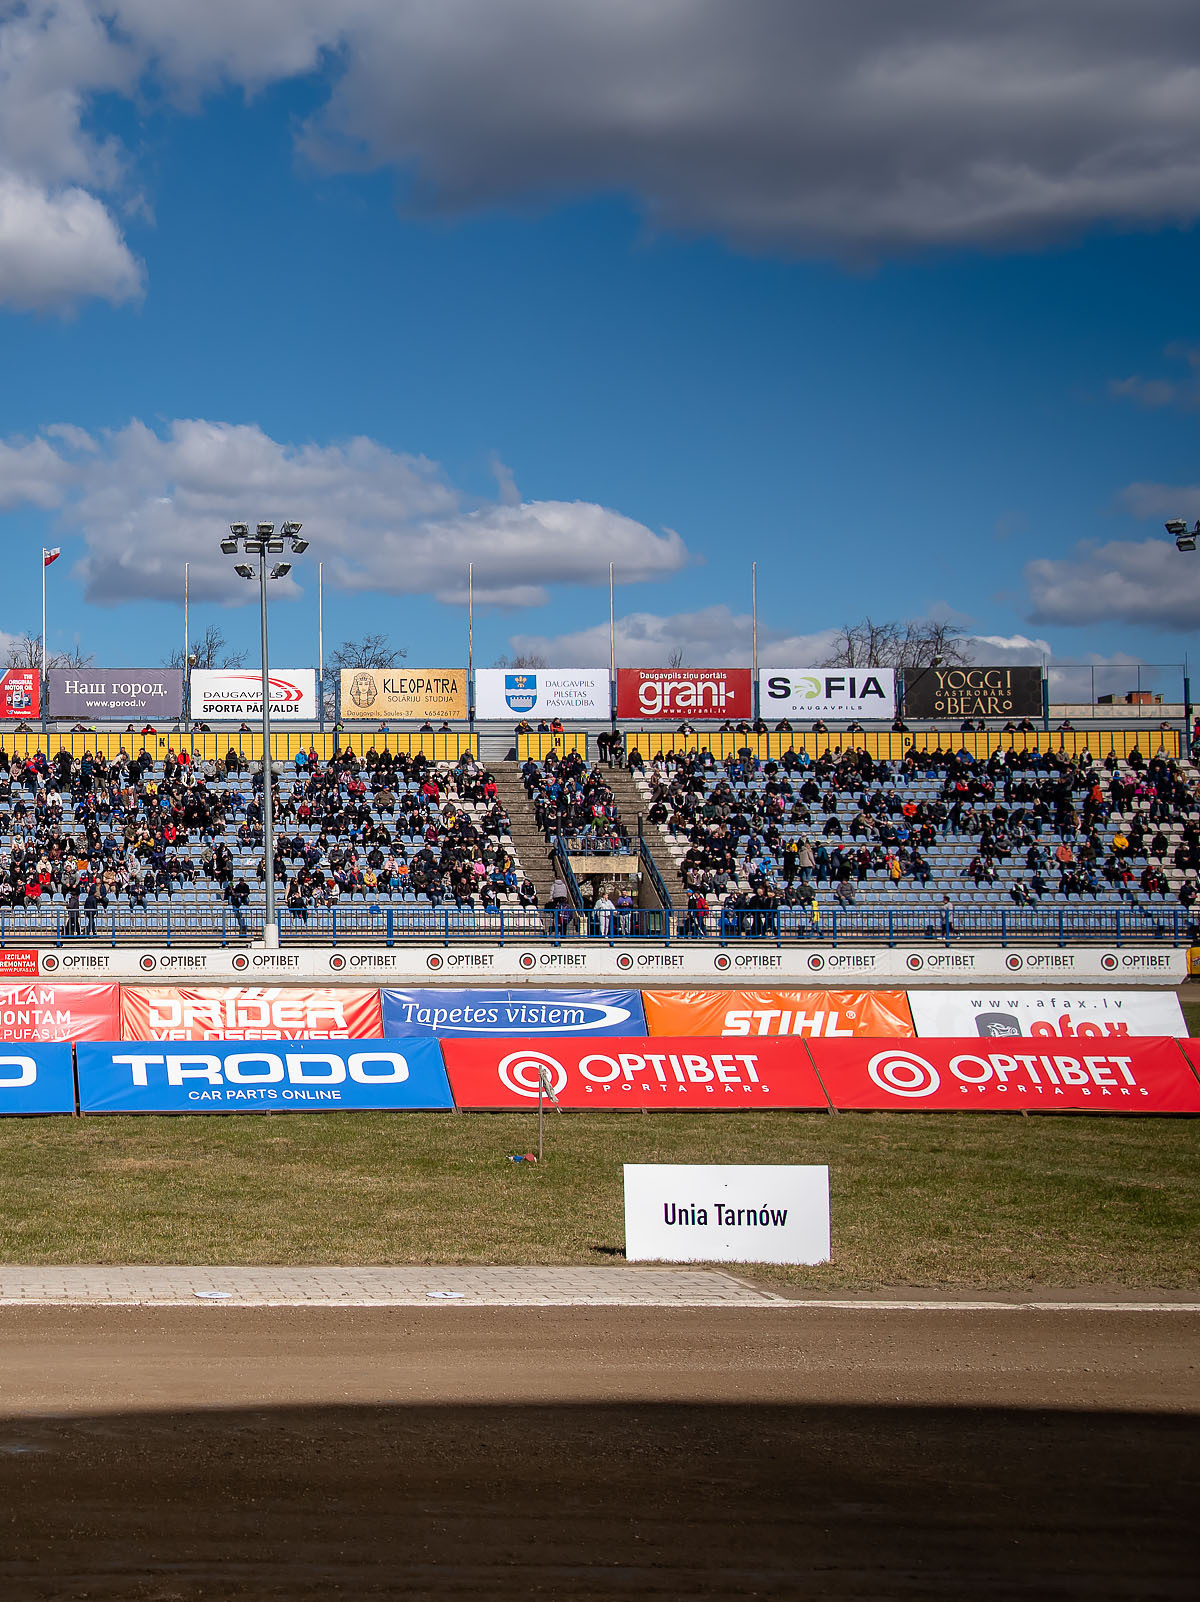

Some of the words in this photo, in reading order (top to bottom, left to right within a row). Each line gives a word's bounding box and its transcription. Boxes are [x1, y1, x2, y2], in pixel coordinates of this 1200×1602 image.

[640, 672, 681, 681] Daugavpils
[935, 671, 1011, 689] YOGGI
[64, 681, 105, 694] Наш
[112, 681, 168, 697] город.
[383, 678, 458, 694] KLEOPATRA
[545, 680, 595, 688] DAUGAVPILS
[203, 691, 284, 699] DAUGAVPLS
[638, 682, 727, 715] grani
[86, 699, 146, 708] www.gorod.lv
[202, 704, 243, 713] SPORTA
[947, 698, 1005, 715] BEAR
[159, 737, 166, 747] K
[554, 737, 561, 747] H
[904, 737, 911, 747] G
[63, 956, 110, 967] OPTIBET
[160, 956, 207, 967] OPTIBET
[252, 955, 300, 966] OPTIBET
[350, 955, 397, 966] OPTIBET
[447, 955, 494, 966] OPTIBET
[540, 954, 587, 965] OPTIBET
[637, 955, 684, 966] OPTIBET
[735, 955, 782, 966] OPTIBET
[828, 955, 875, 966] OPTIBET
[927, 955, 975, 966] OPTIBET
[1026, 955, 1075, 966] OPTIBET
[1122, 955, 1170, 966] OPTIBET
[970, 997, 1123, 1009] www.afax.lv
[402, 1003, 499, 1030] Tapetes
[505, 1004, 586, 1025] visiem
[721, 1010, 854, 1037] STIHL
[111, 1052, 410, 1086] TRODO
[578, 1052, 761, 1083] OPTIBET
[949, 1053, 1137, 1086] OPTIBET
[584, 1083, 688, 1093] SPORTA
[959, 1085, 1064, 1096] SPORTA
[188, 1090, 224, 1101] CAR
[226, 1088, 277, 1100] PARTS
[282, 1089, 342, 1100] ONLINE
[663, 1202, 708, 1226] Unia
[714, 1202, 788, 1227] Tarnów
